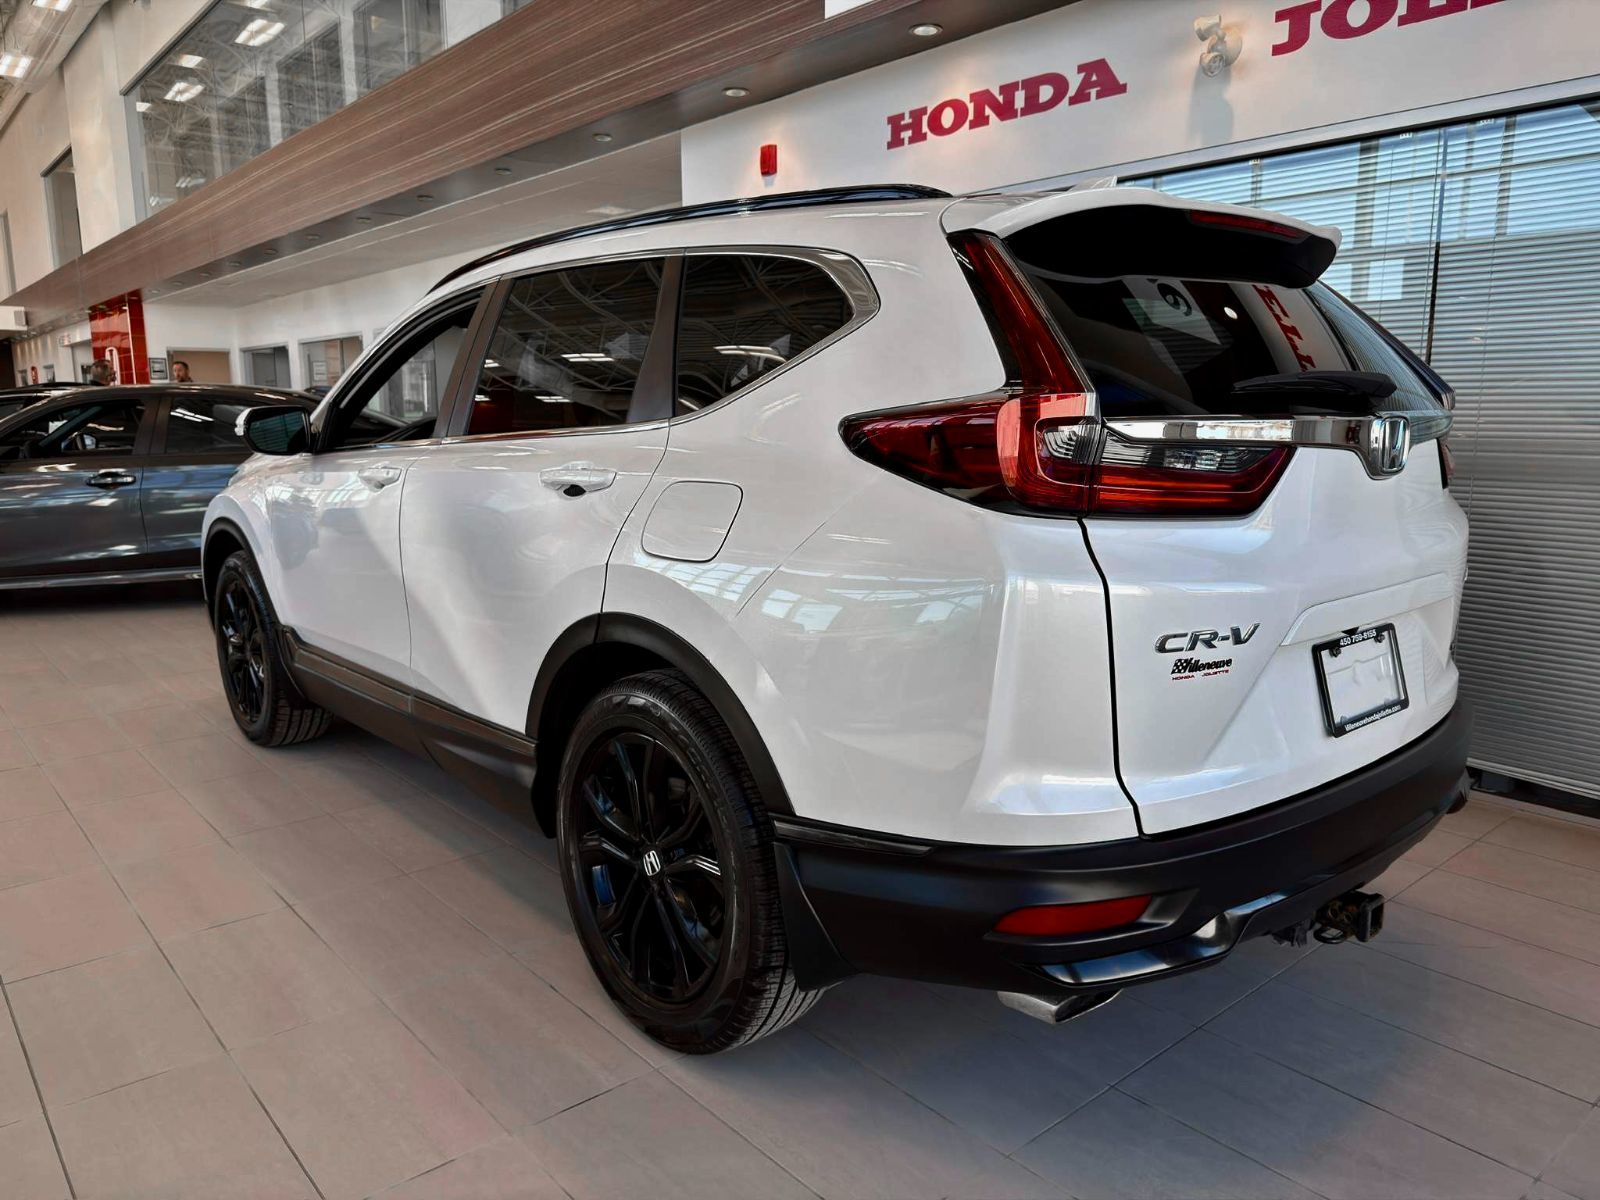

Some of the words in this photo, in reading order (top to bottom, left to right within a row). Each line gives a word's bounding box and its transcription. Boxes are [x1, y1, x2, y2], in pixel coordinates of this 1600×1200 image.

[1271, 0, 1500, 57] JO
[886, 57, 1128, 150] HONDA
[1154, 622, 1261, 654] CR-V
